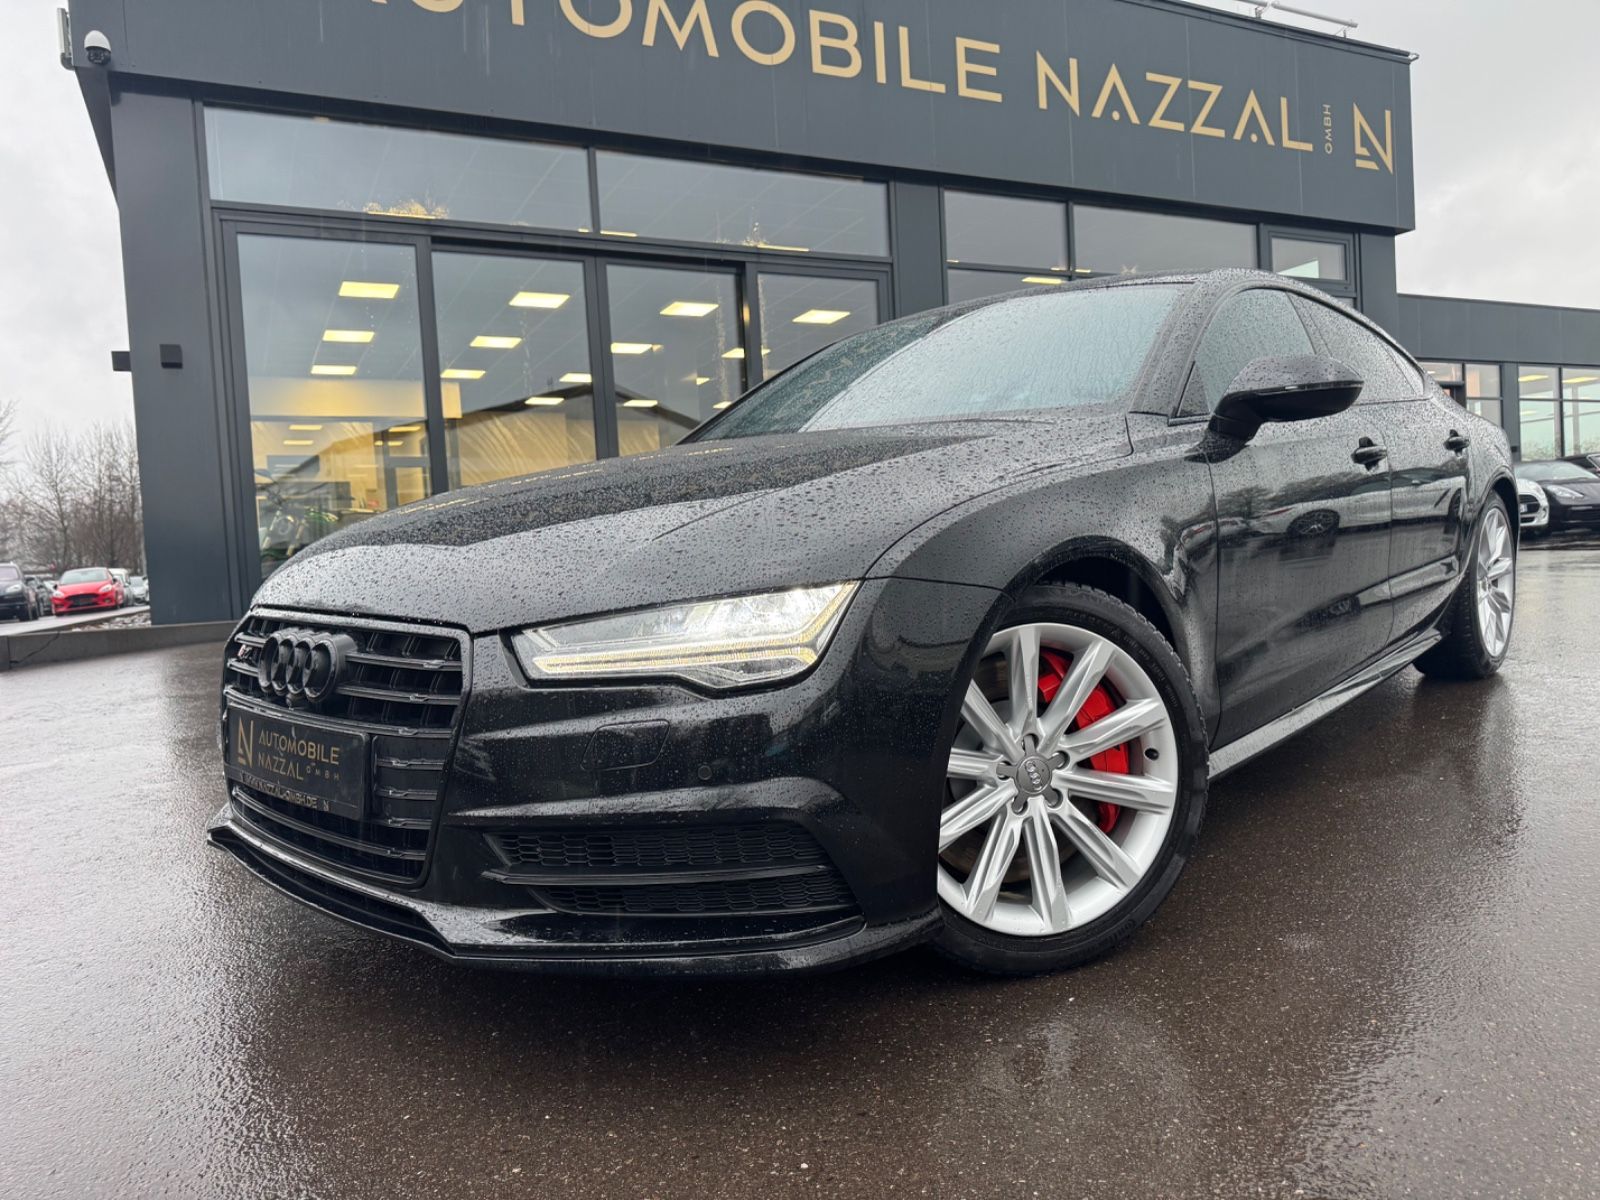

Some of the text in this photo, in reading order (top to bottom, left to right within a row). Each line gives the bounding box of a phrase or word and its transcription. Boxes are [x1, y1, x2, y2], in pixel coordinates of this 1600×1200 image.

[371, 0, 1314, 152] OMOBILE NAZZAL
[258, 729, 341, 766] AUTOMOBILE
[258, 752, 304, 781] NAZZAL
